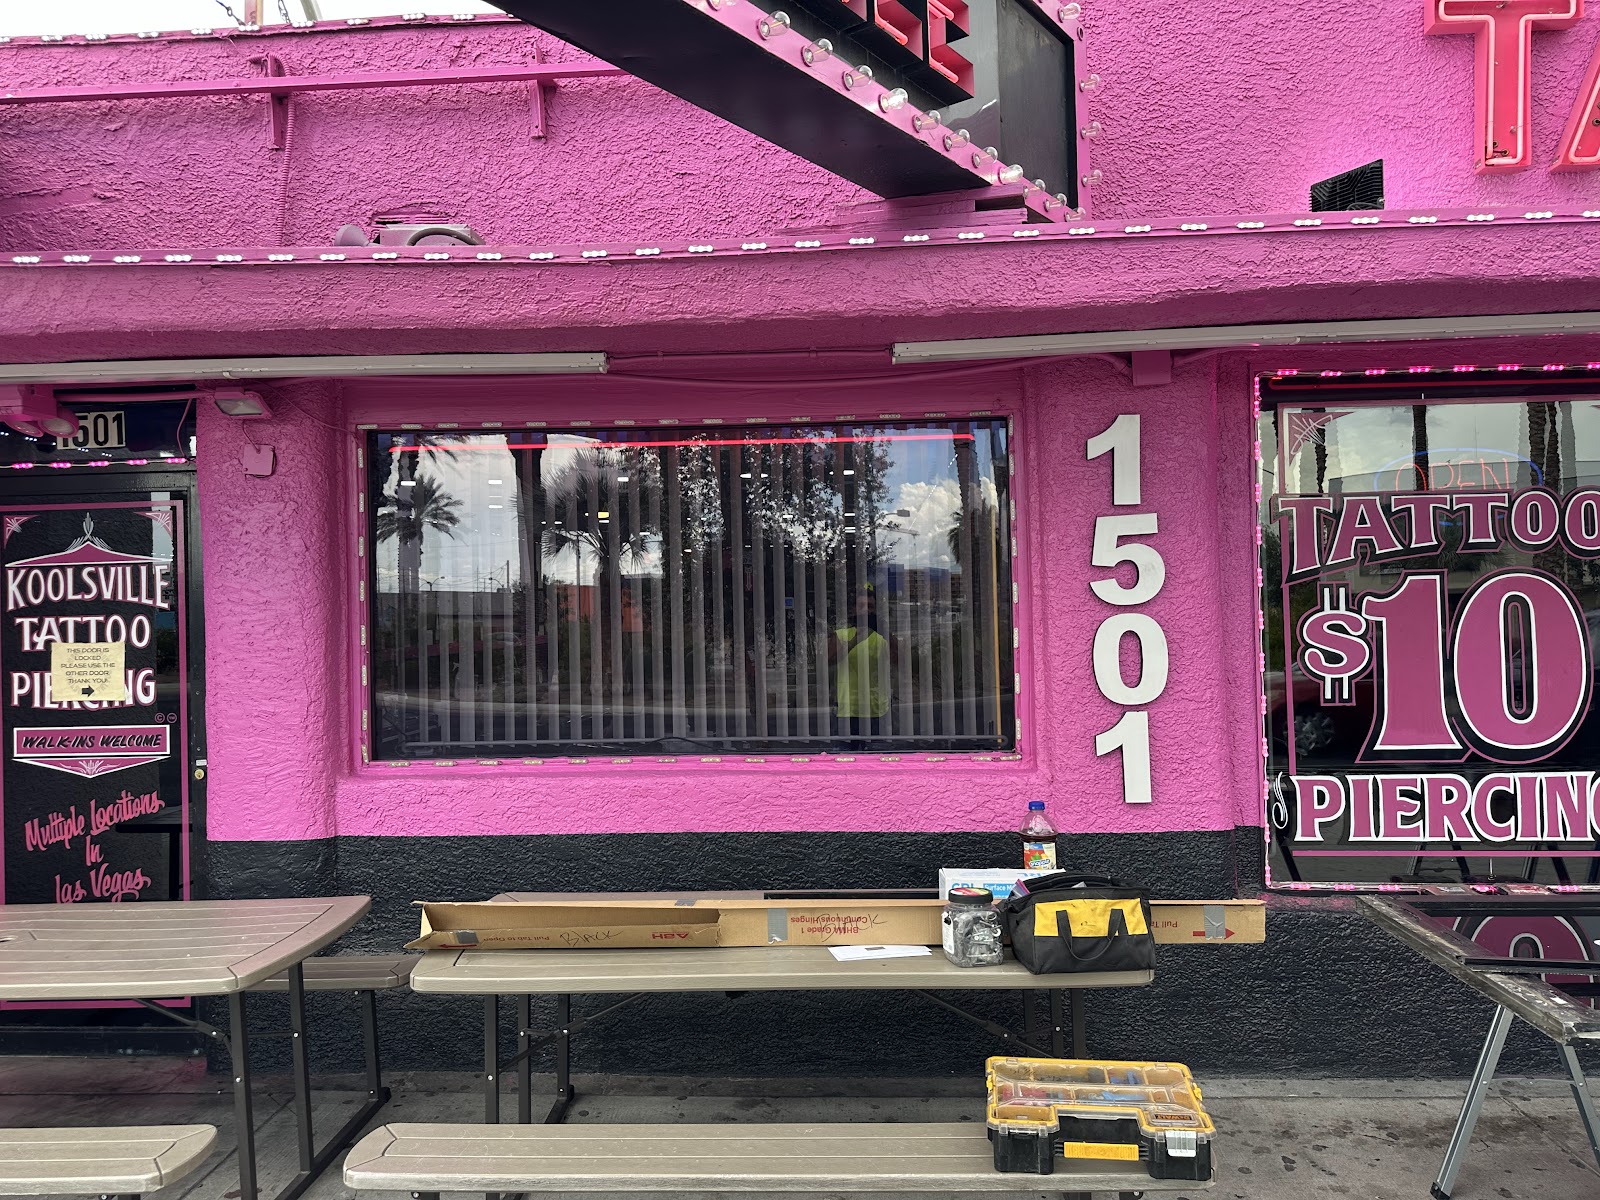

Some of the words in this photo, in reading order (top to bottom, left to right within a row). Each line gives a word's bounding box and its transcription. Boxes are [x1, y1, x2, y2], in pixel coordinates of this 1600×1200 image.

[1277, 489, 1600, 576] TATTOO
[7, 564, 170, 611] KOOLSVILLE
[1086, 413, 1169, 804] 1501
[14, 614, 151, 651] TATTOO
[1302, 572, 1587, 750] $10
[11, 668, 156, 710] PIENG
[21, 735, 95, 750] WALK-INS
[99, 733, 162, 748] WELCOME
[24, 805, 86, 852] Multiple
[90, 789, 165, 836] Locations
[1290, 771, 1600, 842] PIERCIN
[85, 835, 104, 867] In
[90, 862, 151, 904] Vegas
[790, 915, 819, 924] Hinges
[806, 926, 832, 934] Grade
[820, 916, 868, 924] Continuous
